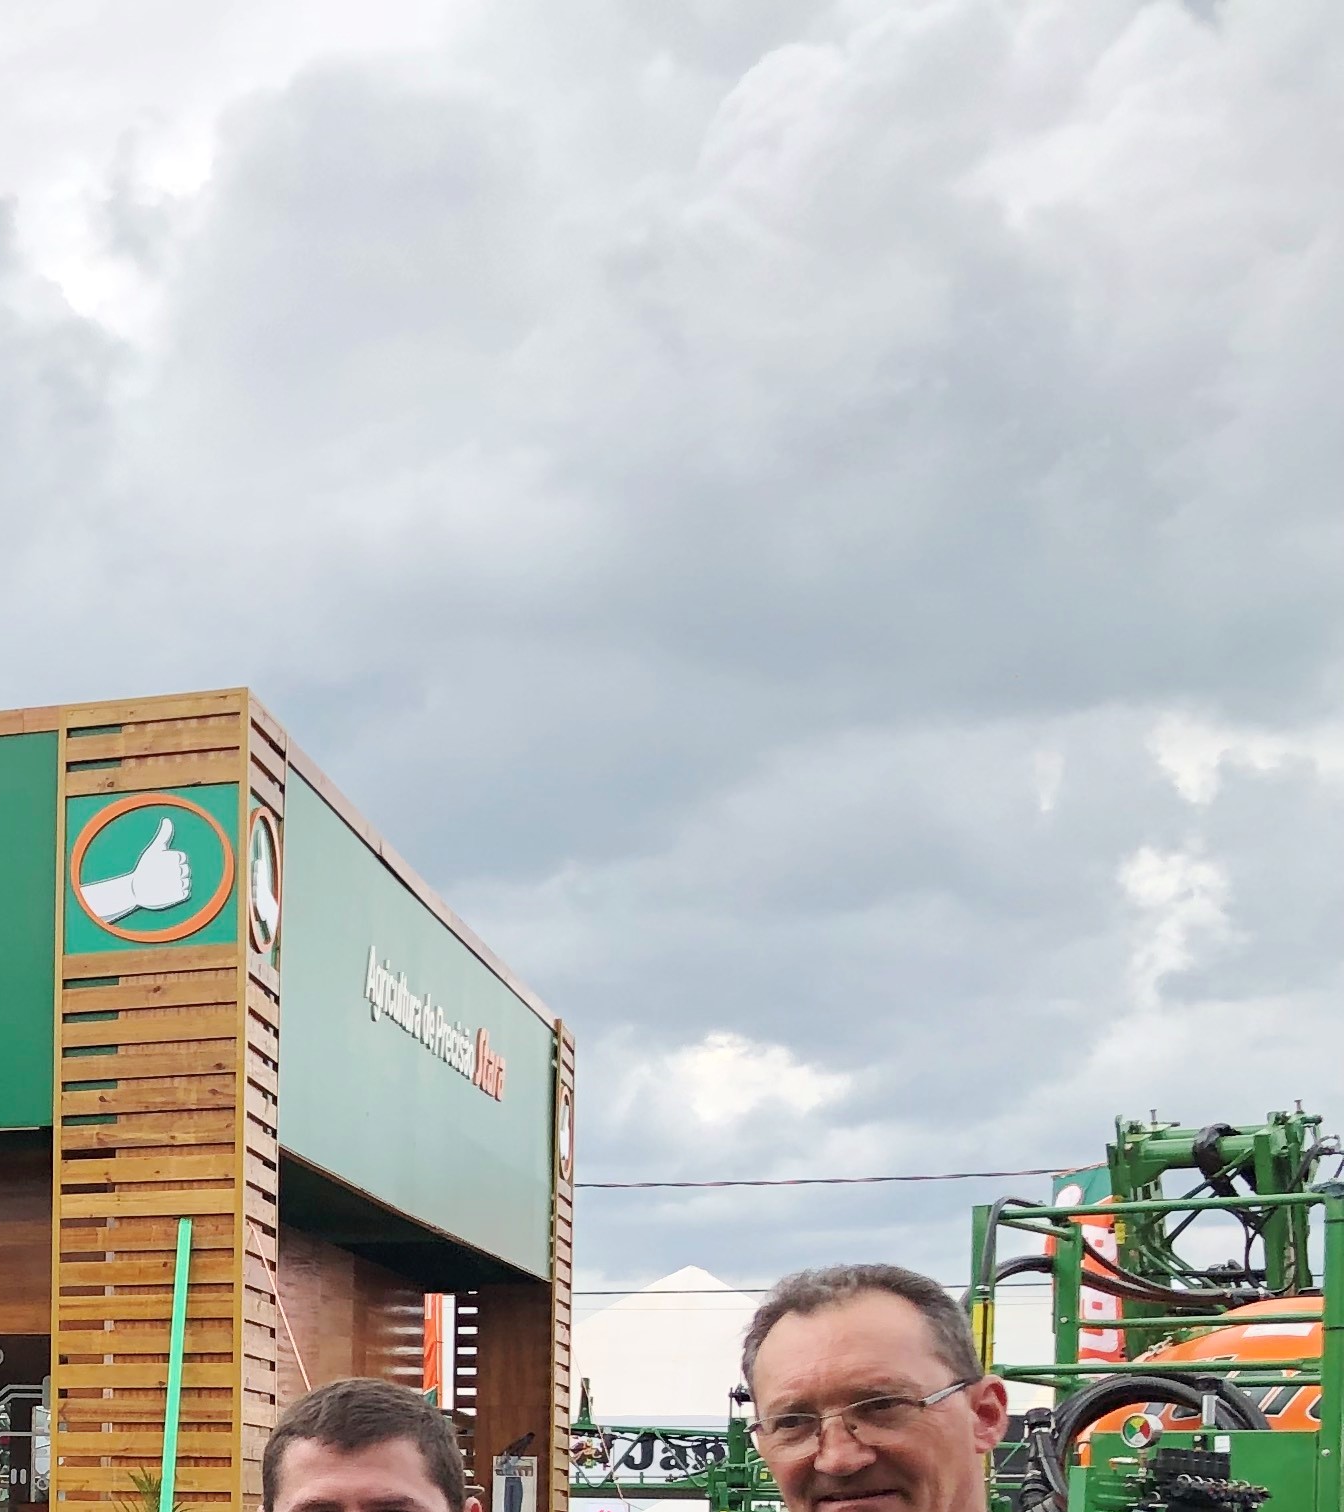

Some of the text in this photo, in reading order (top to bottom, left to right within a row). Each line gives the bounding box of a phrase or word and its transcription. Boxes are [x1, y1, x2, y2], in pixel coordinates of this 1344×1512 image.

[364, 945, 506, 1103] Agricultura de Precisão Stara
